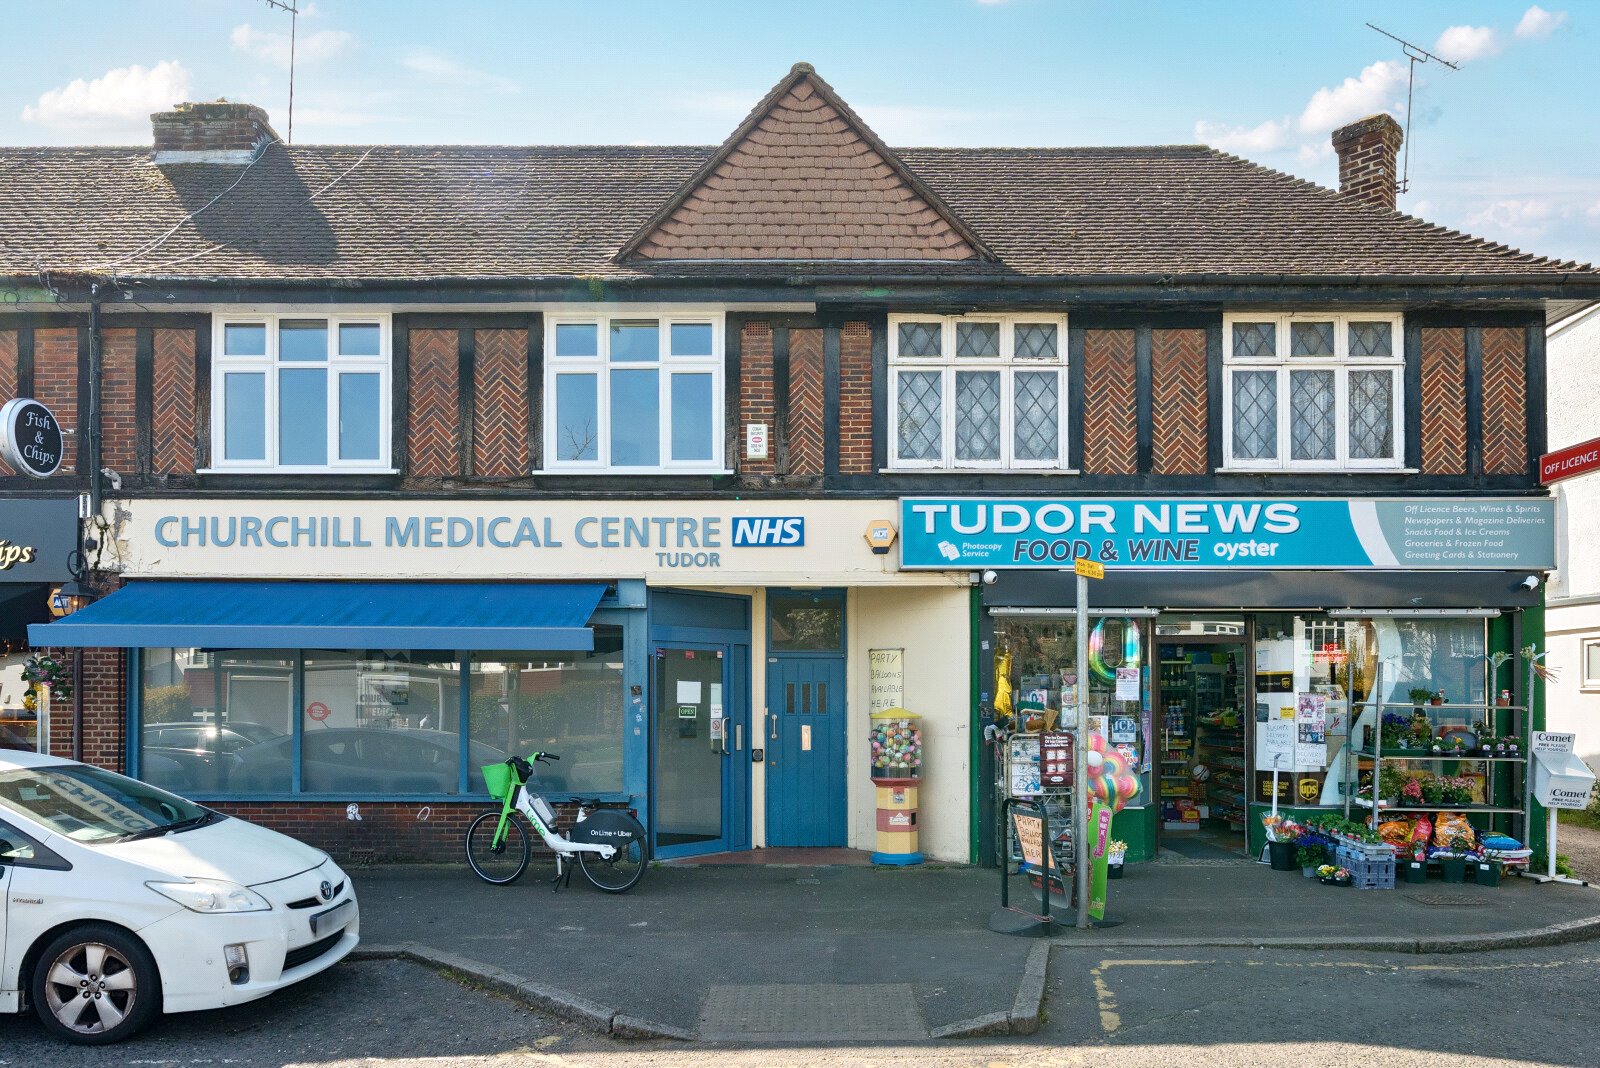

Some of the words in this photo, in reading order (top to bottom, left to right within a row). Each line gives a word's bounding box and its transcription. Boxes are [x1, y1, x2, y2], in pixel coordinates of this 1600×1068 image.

[26, 410, 51, 430] Fish
[34, 431, 44, 445] &
[23, 444, 55, 466] Chips
[1544, 464, 1561, 475] OFF
[1560, 450, 1598, 471] LICENCE
[1404, 505, 1418, 514] Off
[1420, 505, 1450, 513] Licence
[1452, 505, 1477, 515] Beers,
[1480, 505, 1504, 513] Wines
[1506, 505, 1512, 513] &
[1515, 505, 1541, 514] Spirits
[912, 503, 1118, 535] TUDOR
[1134, 503, 1301, 535] NEWS
[1404, 516, 1454, 527] Newspapers
[1456, 517, 1462, 525] &
[1465, 517, 1504, 527] Magazine
[1506, 516, 1546, 525] Deliveries
[154, 515, 372, 548] CHURCHILL
[385, 515, 563, 548] MEDICAL
[576, 515, 721, 548] CENTRE
[734, 518, 802, 545] NHS
[873, 530, 887, 538] ADT
[1405, 528, 1432, 536] Snacks
[1434, 528, 1454, 536] Food
[1456, 528, 1462, 536] &
[1465, 528, 1477, 536] Ice
[1479, 528, 1510, 536] Creams
[962, 542, 1002, 553] Photocopy
[1213, 540, 1279, 558] oyster
[1404, 539, 1444, 548] Groceries
[1446, 540, 1452, 548] &
[1455, 539, 1482, 548] Frozen
[1484, 539, 1504, 548] Food
[962, 550, 990, 558] Service
[1013, 538, 1092, 562] FOOD
[1099, 538, 1119, 562] &
[1128, 538, 1200, 562] WINE
[1404, 550, 1440, 561] Greeting
[1442, 550, 1466, 559] Cards
[1468, 551, 1475, 559] &
[1477, 551, 1519, 561] Stationery
[655, 551, 721, 568] TUDOR
[870, 653, 898, 663] PARTY
[871, 670, 901, 679] BALLOONS
[871, 685, 903, 693] AVAILABLE
[871, 699, 895, 707] HERE
[681, 708, 694, 716] OPEN
[1114, 720, 1134, 731] ICE
[1538, 732, 1572, 742] Comet
[1301, 784, 1317, 797] ups
[1552, 788, 1587, 798] Comet
[525, 809, 546, 837] Lime
[1016, 815, 1040, 829] PARTY
[599, 829, 613, 837] Lime
[1021, 827, 1042, 838] BALLOO
[1025, 848, 1041, 858] HER
